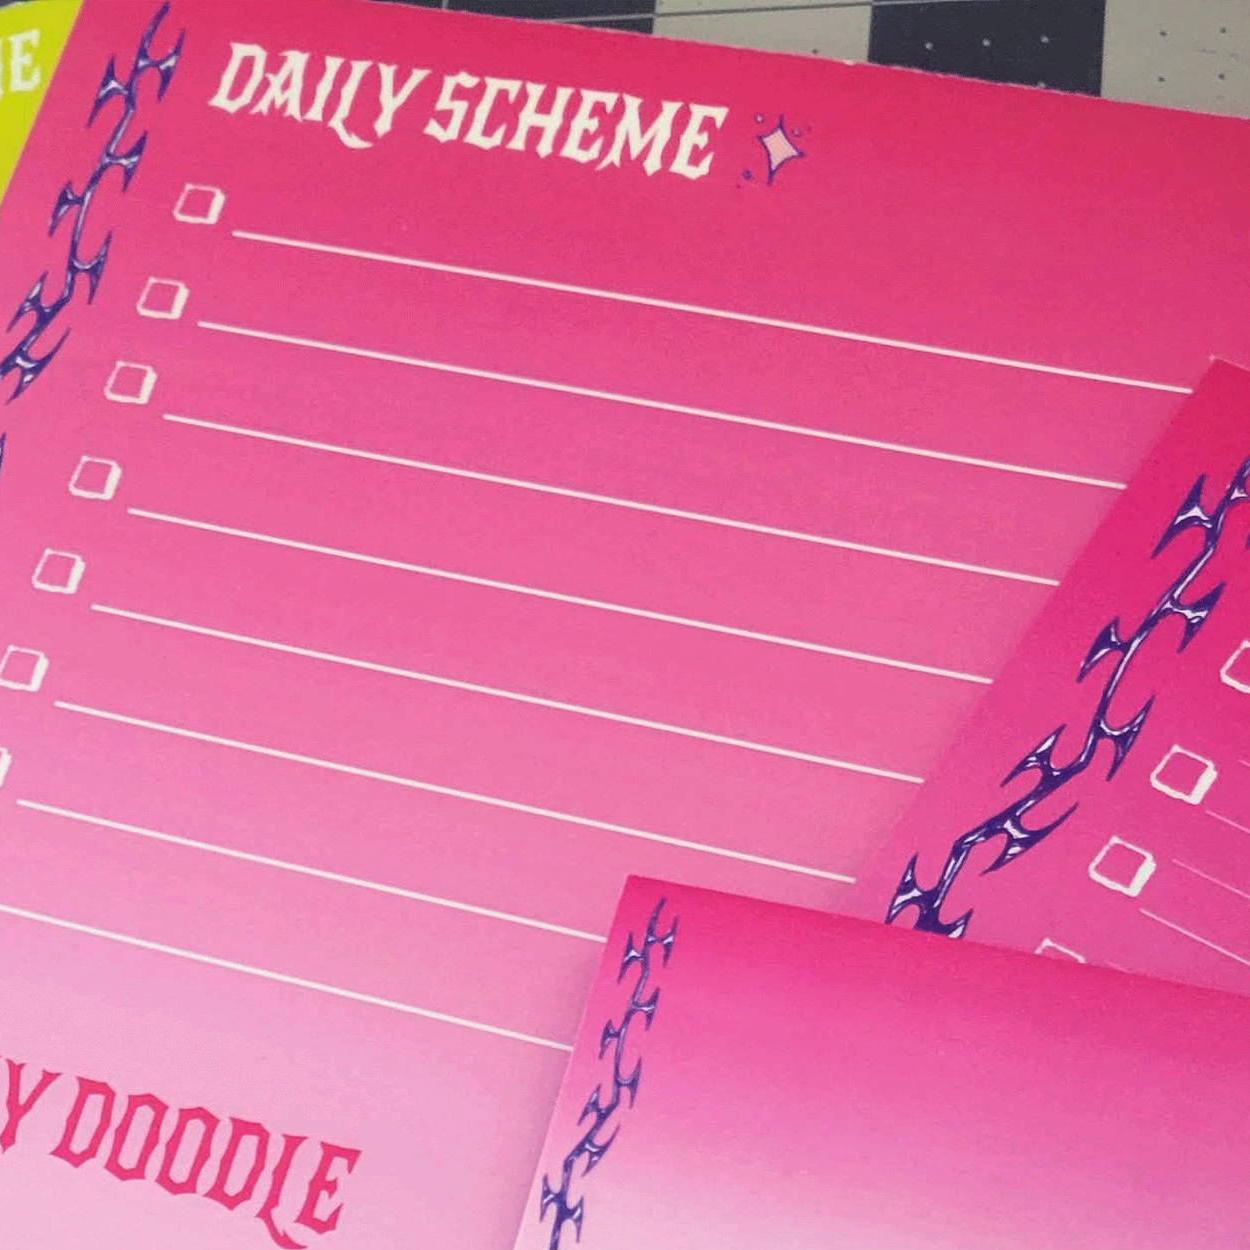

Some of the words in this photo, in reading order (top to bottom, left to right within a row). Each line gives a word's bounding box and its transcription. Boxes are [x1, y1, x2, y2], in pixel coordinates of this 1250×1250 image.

[209, 42, 431, 149] DAILY
[424, 71, 730, 180] SCHEME
[50, 1076, 363, 1250] DOODLE
